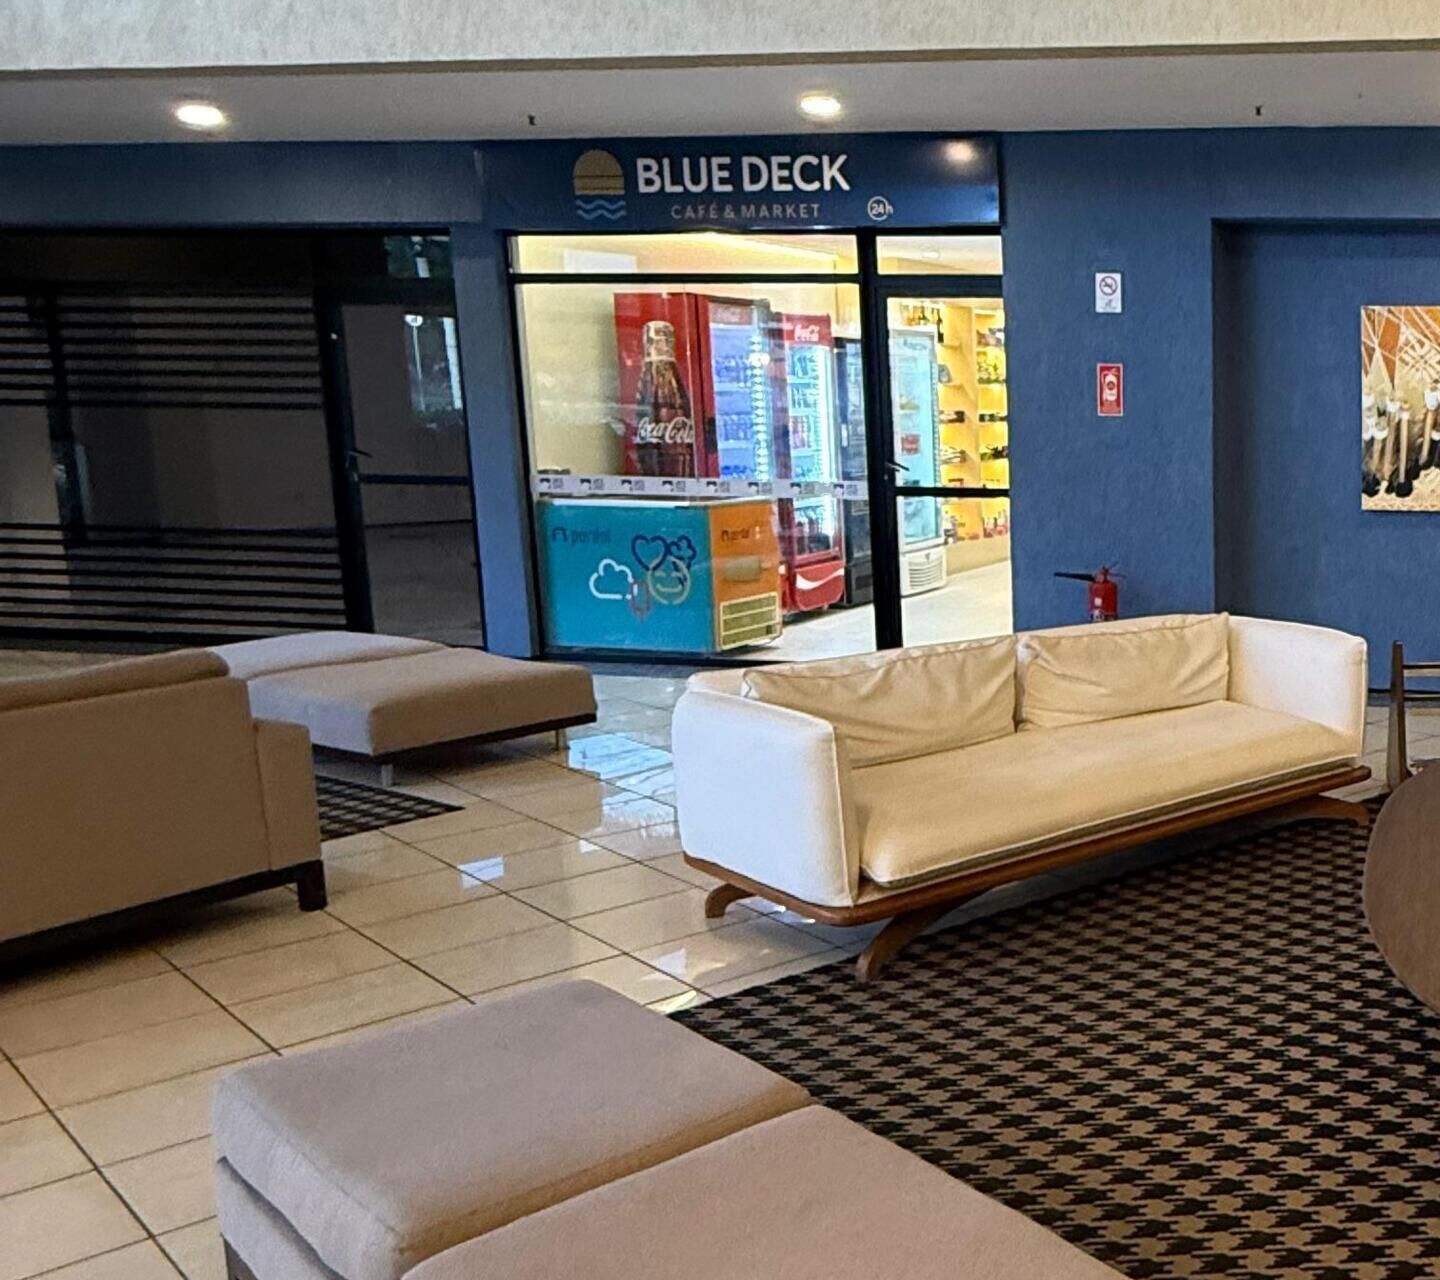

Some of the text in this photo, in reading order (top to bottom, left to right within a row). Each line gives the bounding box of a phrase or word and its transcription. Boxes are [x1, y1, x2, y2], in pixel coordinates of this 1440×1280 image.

[636, 154, 850, 193] BLUE DECK
[671, 201, 820, 219] CAFÉ & MARKET
